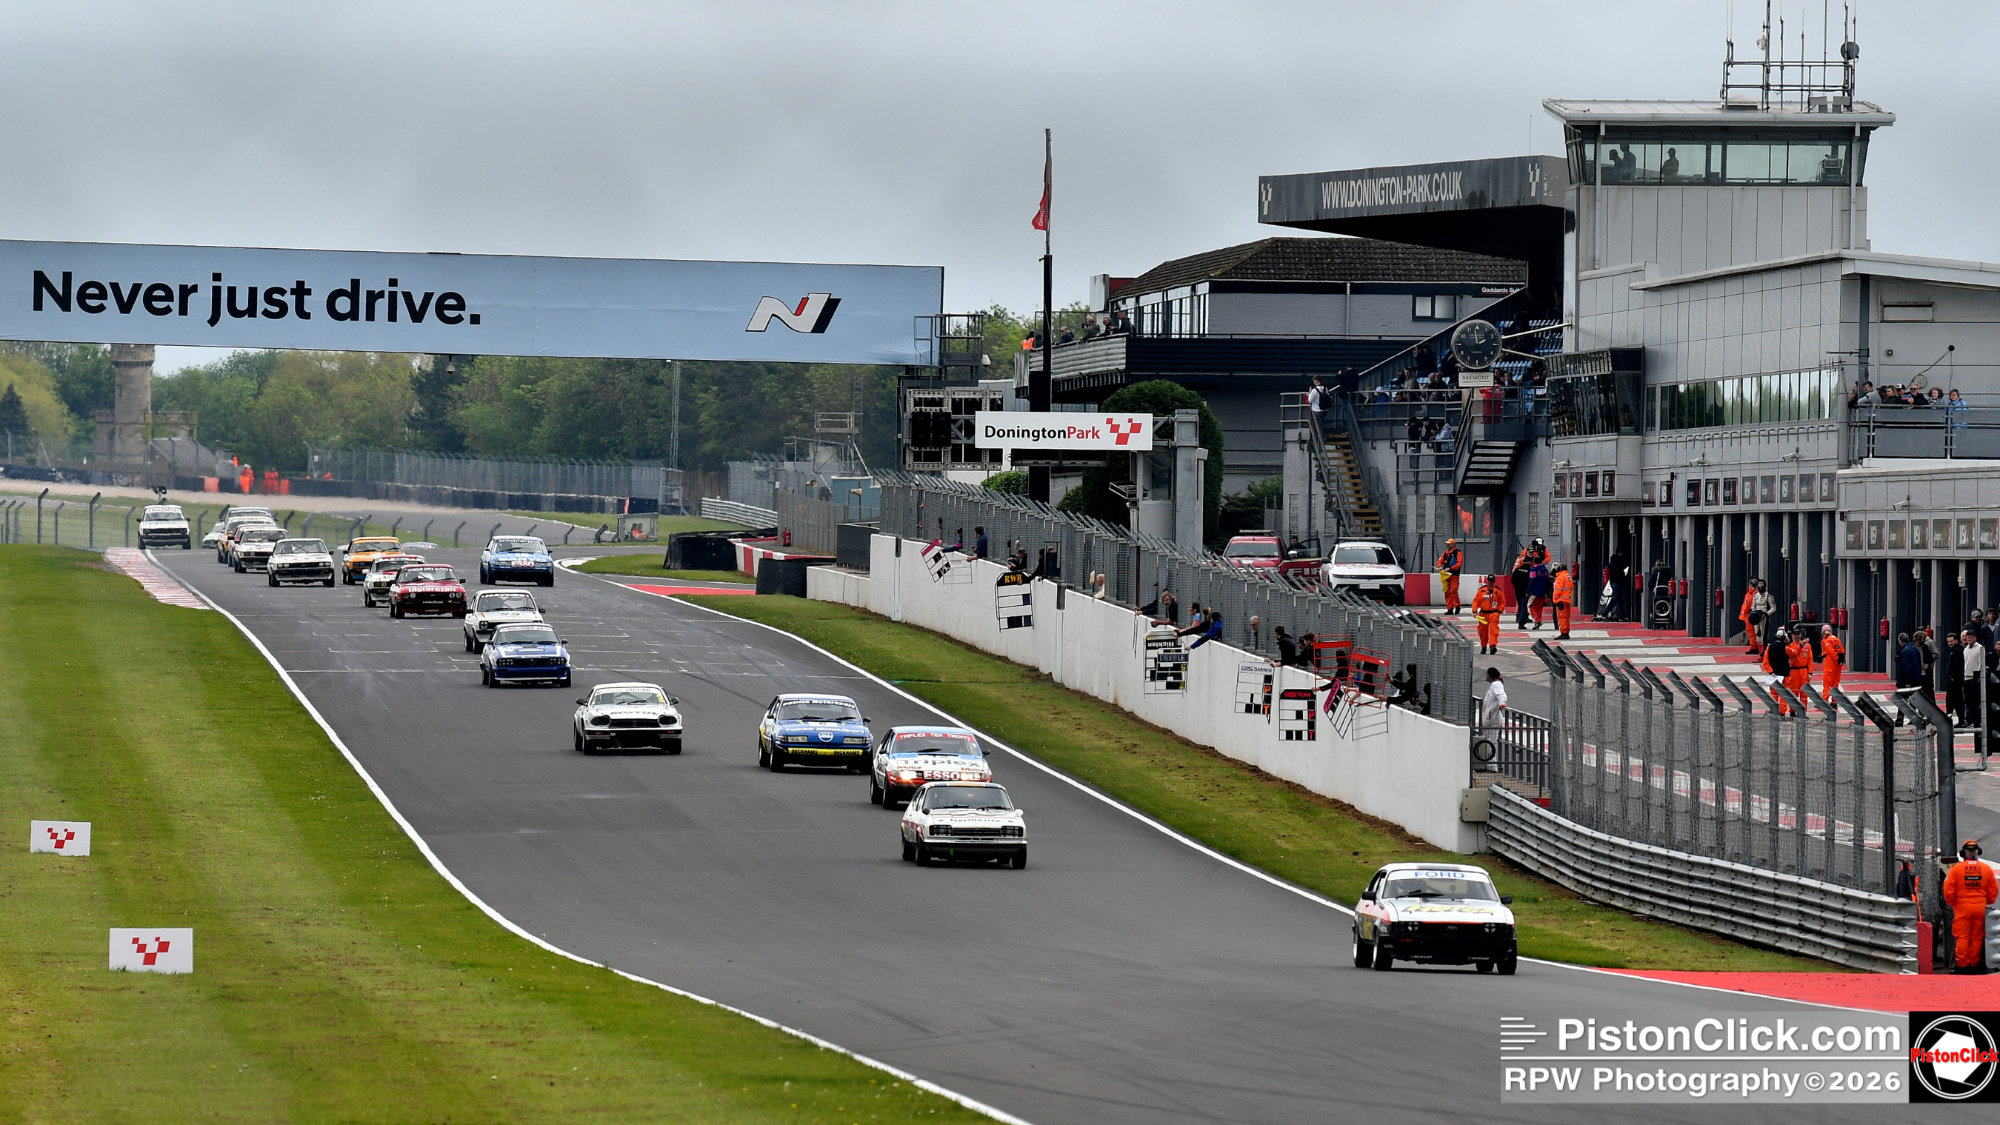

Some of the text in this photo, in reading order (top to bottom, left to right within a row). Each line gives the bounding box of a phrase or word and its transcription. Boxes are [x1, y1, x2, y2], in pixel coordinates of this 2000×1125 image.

[1322, 171, 1463, 210] WWW.DONINGTON-PARK.CO.UK
[32, 269, 481, 328] Never just drive.
[984, 425, 1101, 441] DoningtonPark
[1264, 685, 1272, 694] P
[1308, 710, 1316, 720] P
[923, 771, 960, 780] ESSO
[1414, 871, 1465, 879] FORD
